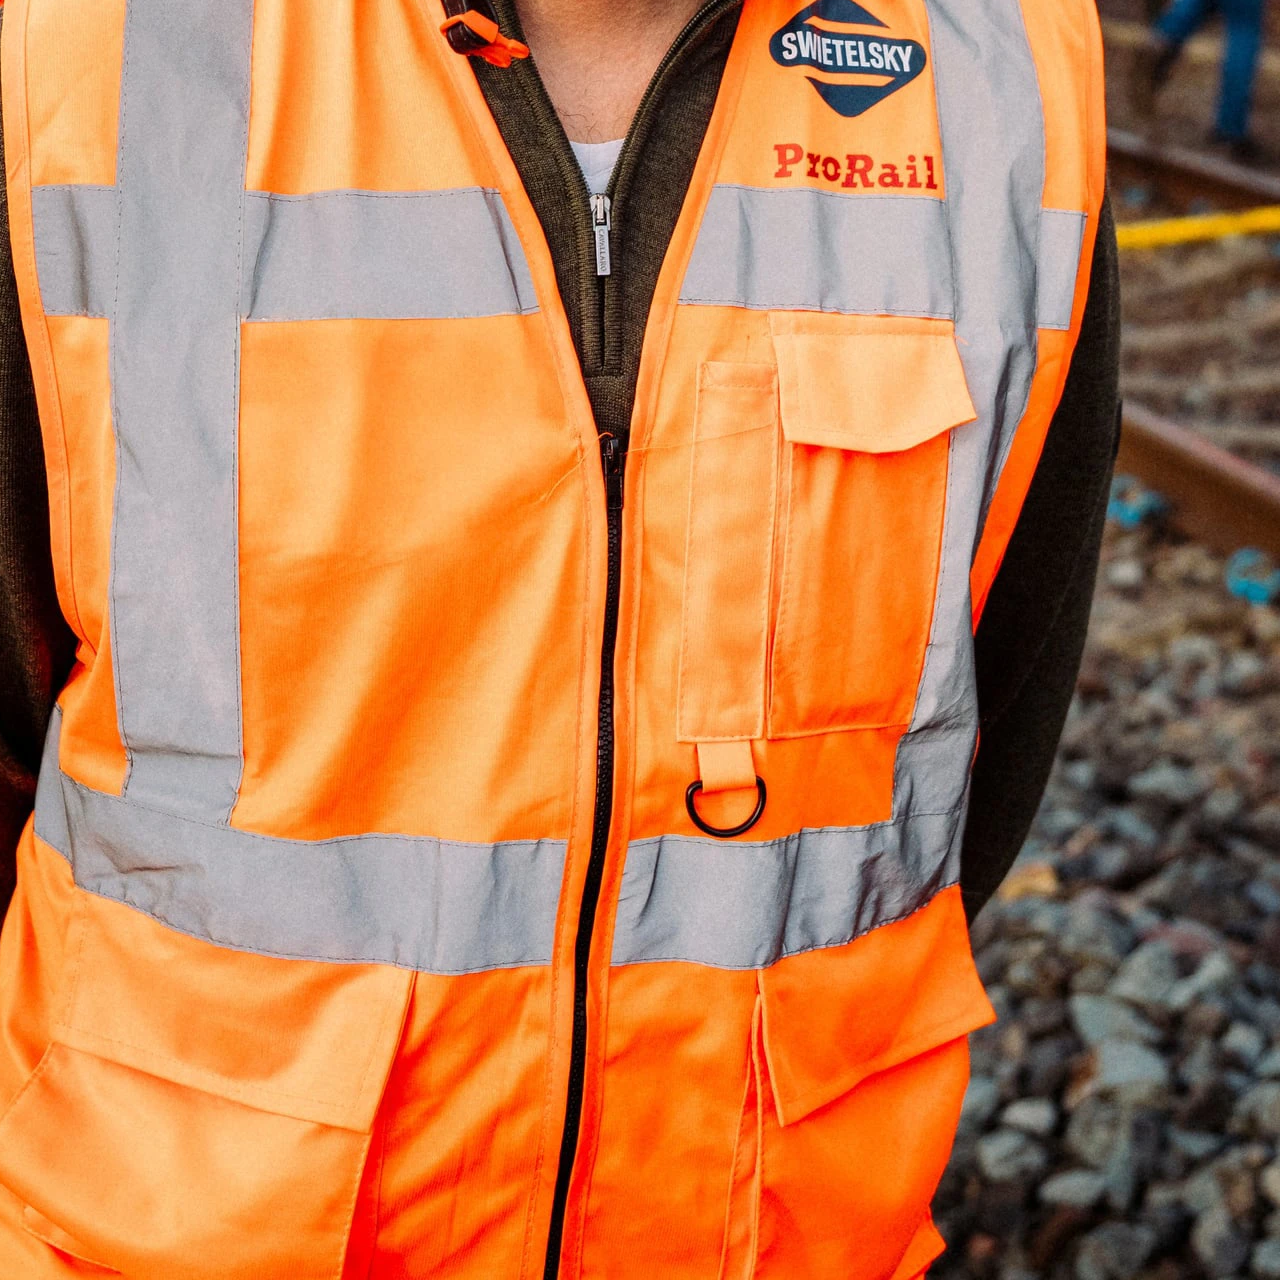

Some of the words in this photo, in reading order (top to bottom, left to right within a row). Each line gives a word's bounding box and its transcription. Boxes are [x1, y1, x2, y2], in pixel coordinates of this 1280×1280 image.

[781, 30, 913, 73] SWIETELSKY
[773, 143, 938, 190] ProRail
[598, 228, 608, 272] CAVALLARO
